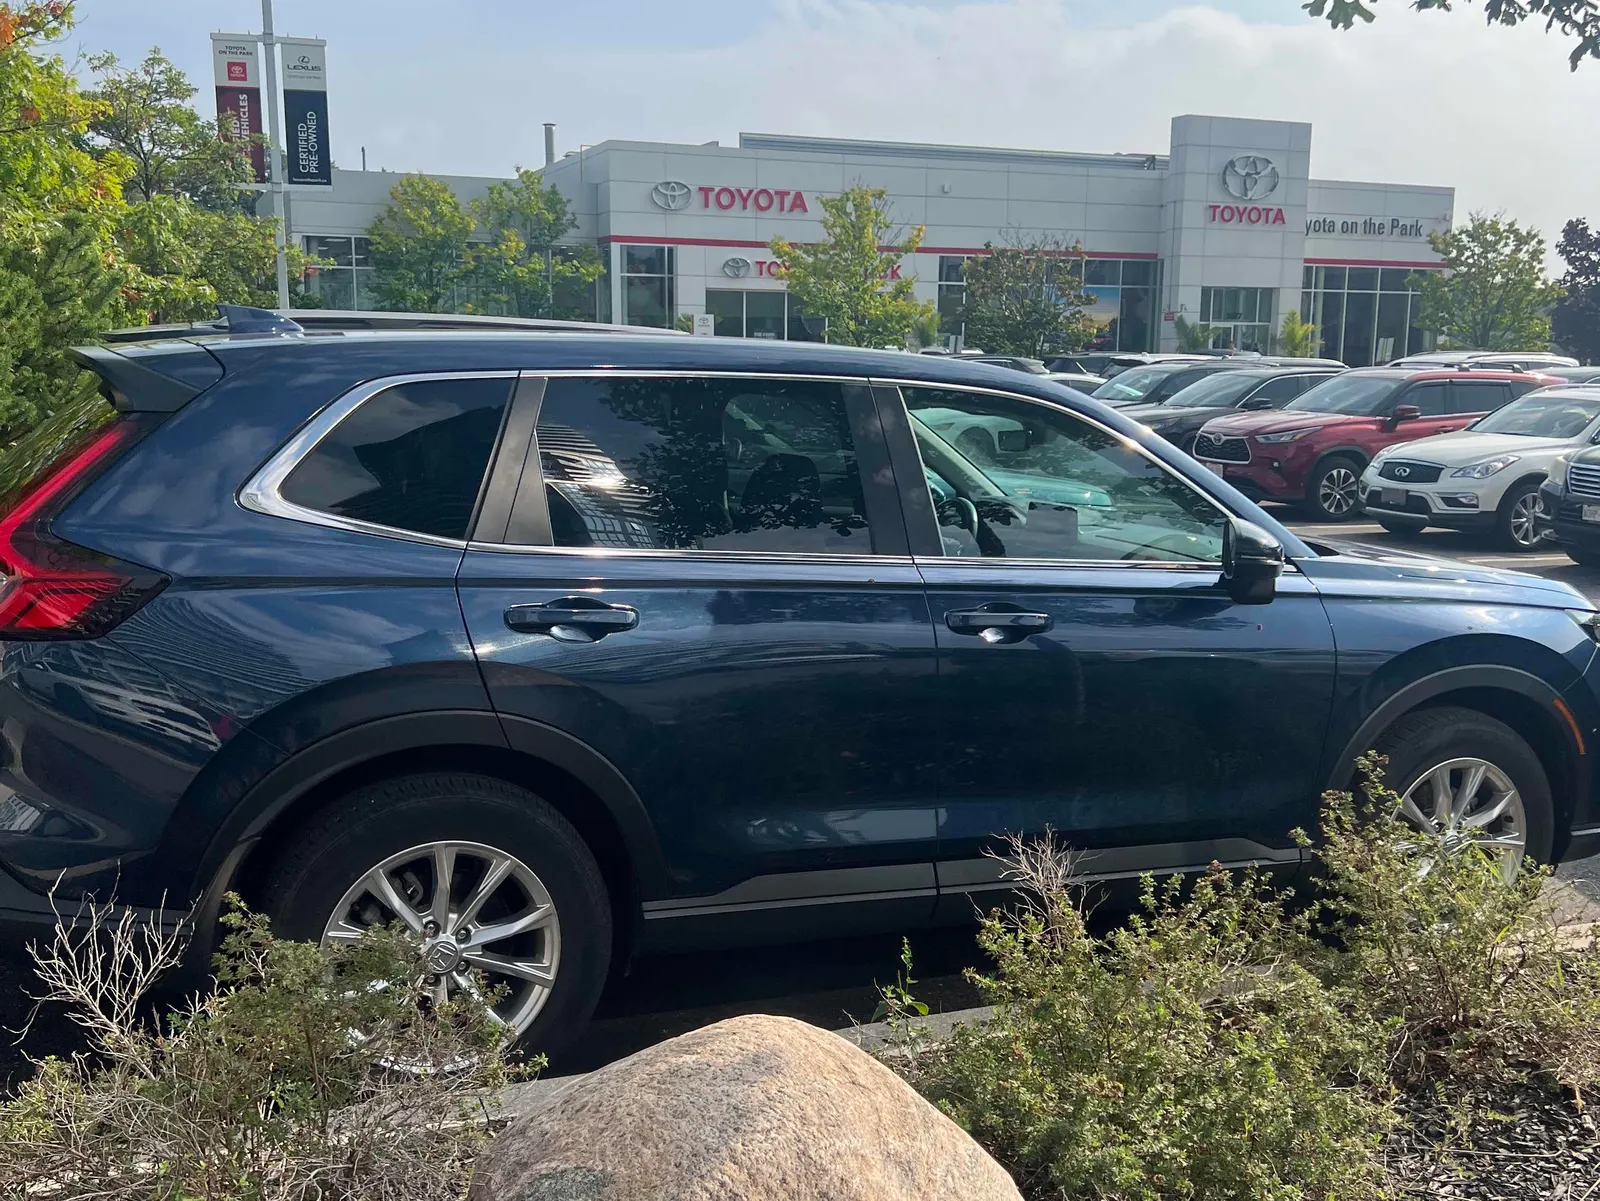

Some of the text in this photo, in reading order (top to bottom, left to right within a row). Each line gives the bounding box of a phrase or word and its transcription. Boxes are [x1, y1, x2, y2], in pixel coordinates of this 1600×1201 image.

[287, 64, 321, 72] LEXUS
[239, 93, 250, 142] VEHICLES
[298, 123, 309, 173] CERTIFIED
[306, 111, 319, 173] PRE-OWNED
[698, 186, 808, 213] TOYOTA
[1208, 204, 1286, 225] TOYOTA
[1305, 217, 1423, 237] yota on the Park
